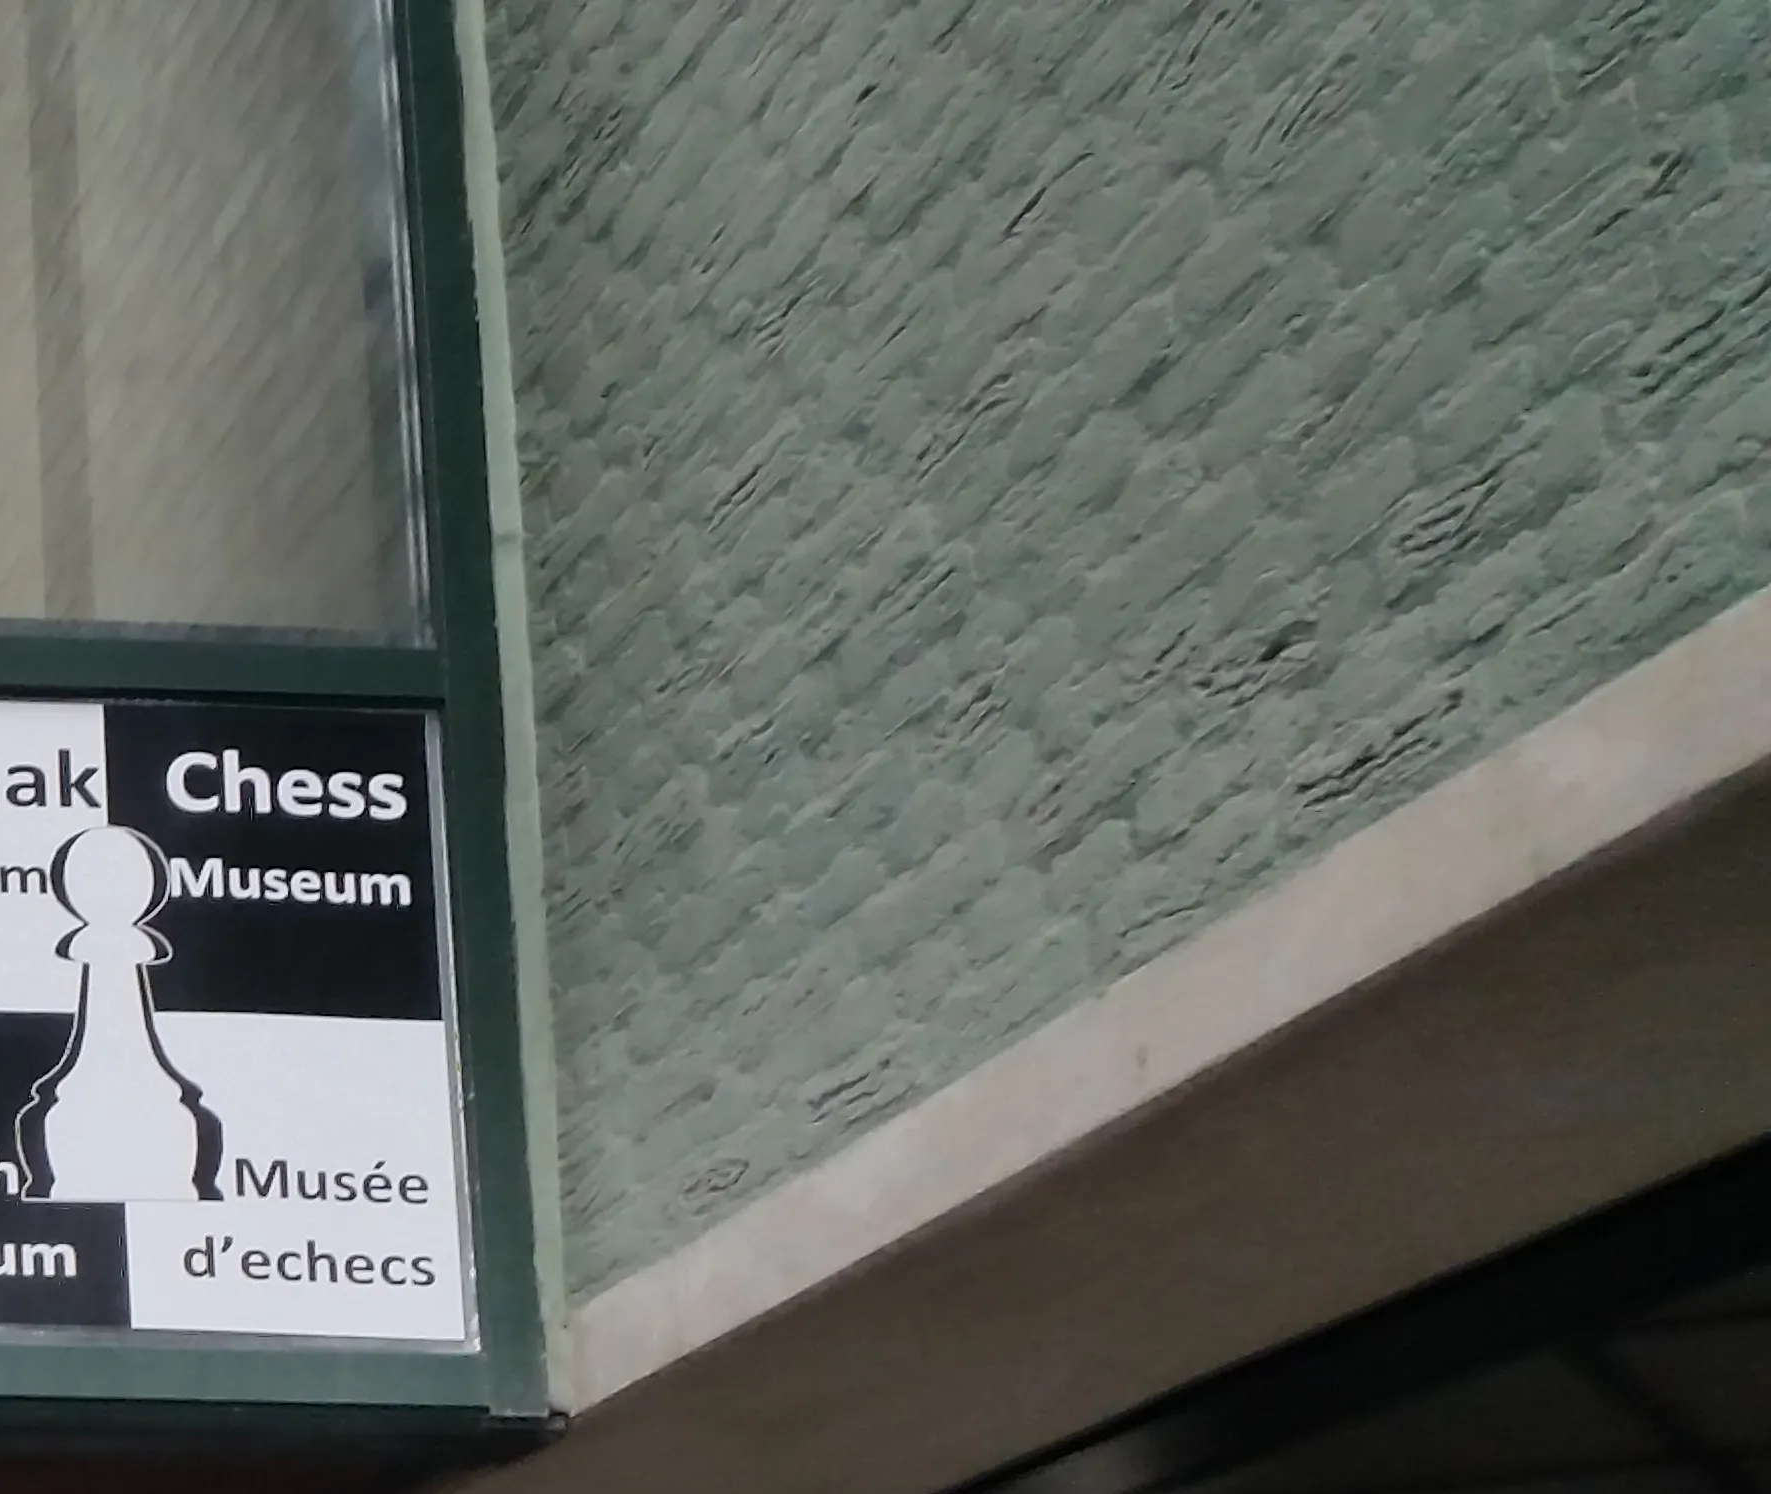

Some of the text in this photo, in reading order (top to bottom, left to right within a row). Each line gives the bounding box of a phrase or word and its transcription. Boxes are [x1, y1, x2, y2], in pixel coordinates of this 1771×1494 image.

[165, 750, 408, 821] Chess
[169, 857, 413, 907] Museum
[235, 1158, 430, 1204] Musée
